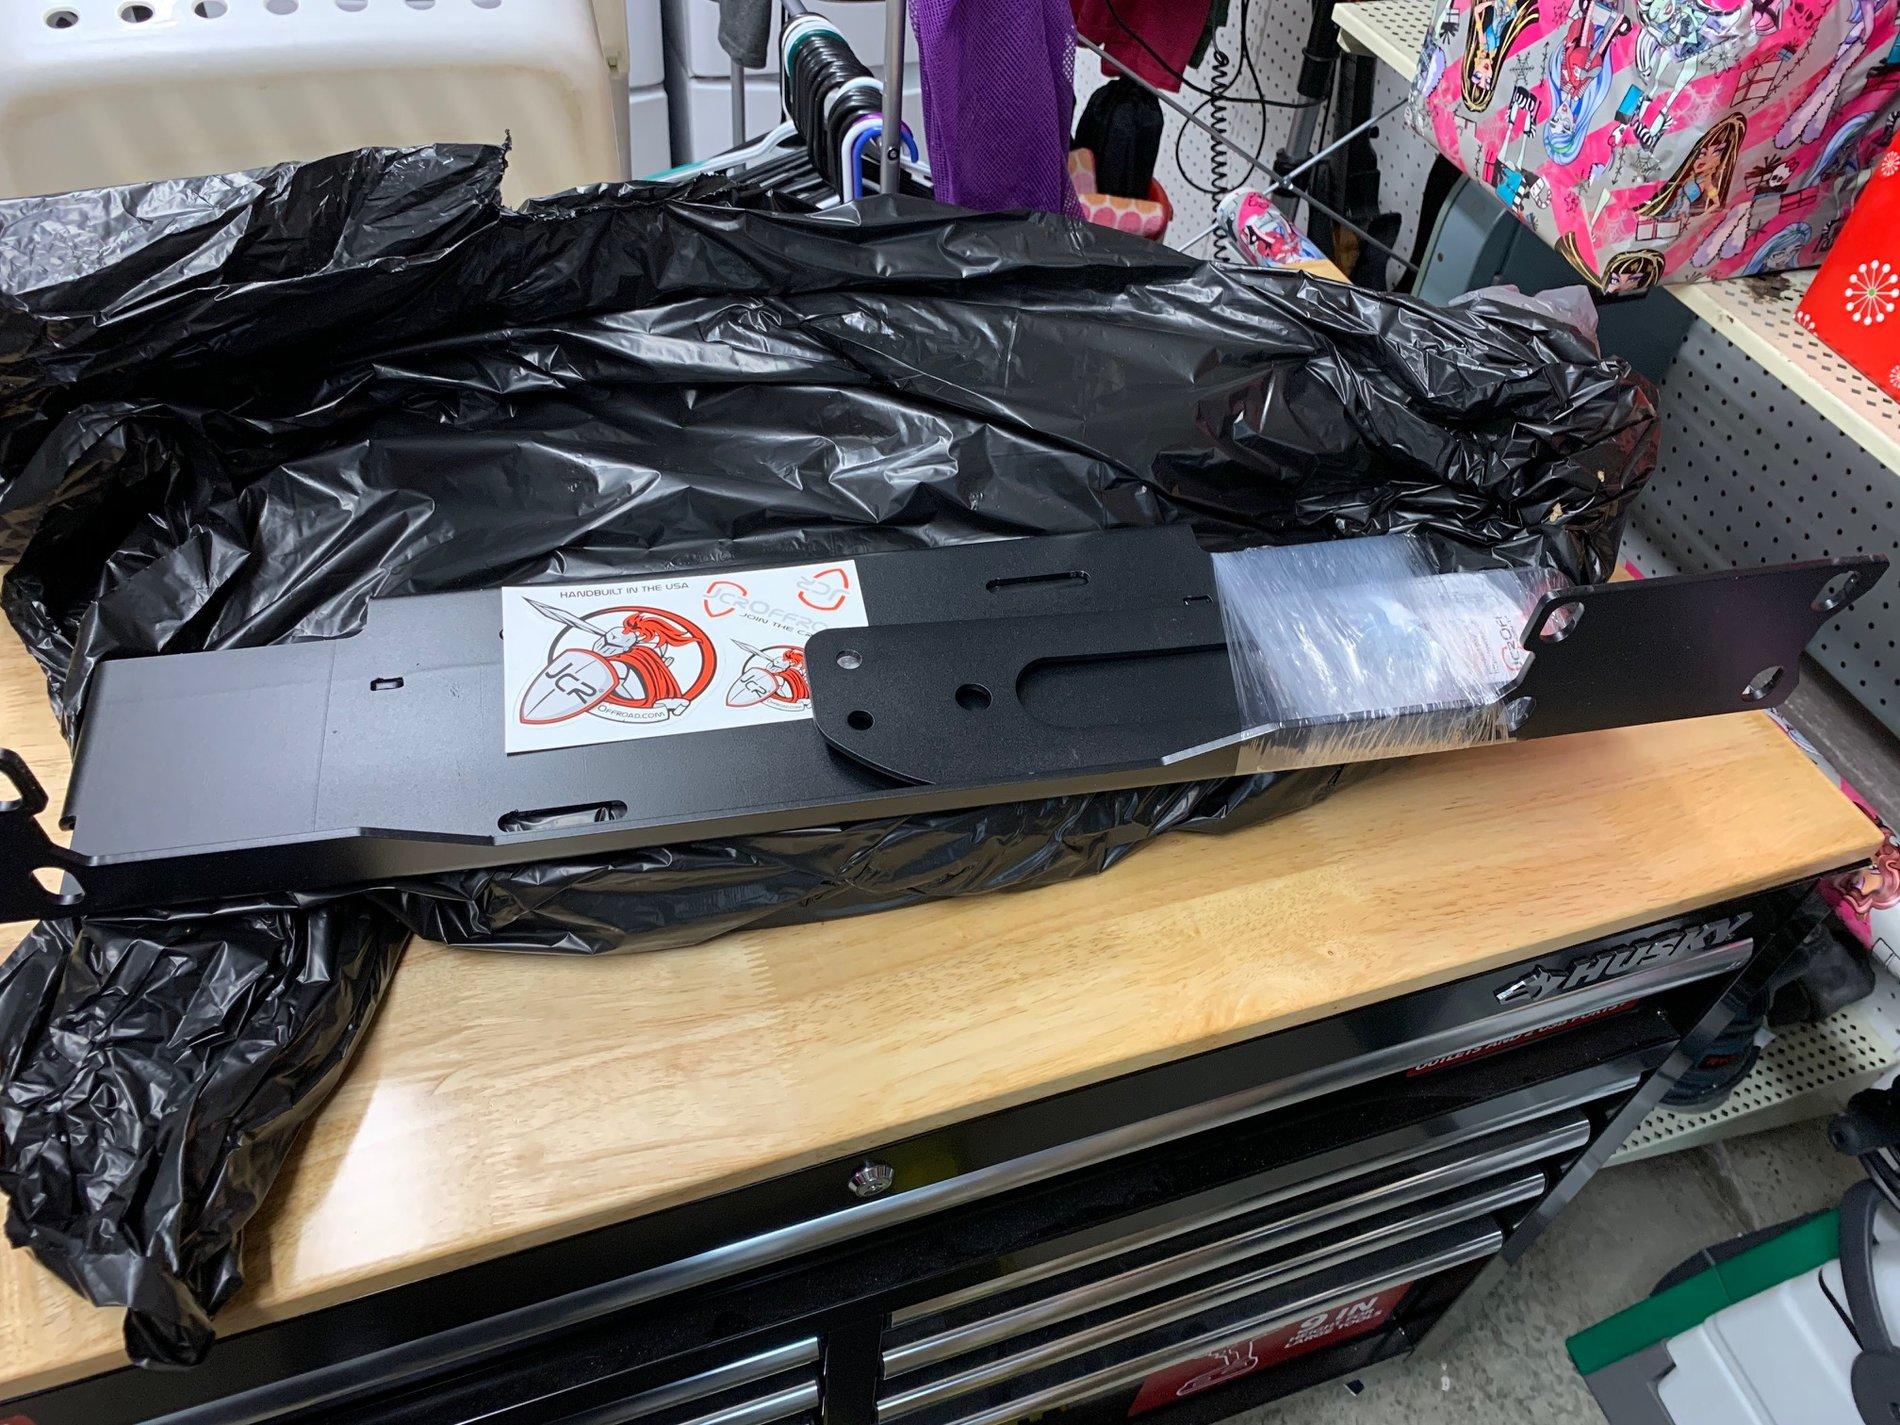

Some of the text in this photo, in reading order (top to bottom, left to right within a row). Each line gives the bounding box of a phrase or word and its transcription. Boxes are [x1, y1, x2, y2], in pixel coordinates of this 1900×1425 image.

[560, 587, 623, 599] HANDBUILT
[642, 584, 663, 593] THE
[665, 582, 690, 590] USA
[702, 588, 829, 632] JCROFFRO
[739, 613, 769, 625] JOIN
[772, 621, 795, 633] THE
[545, 662, 597, 705] JCR
[740, 674, 768, 698] JCR
[1562, 911, 1754, 989] HUSKY
[1335, 1296, 1379, 1326] IN
